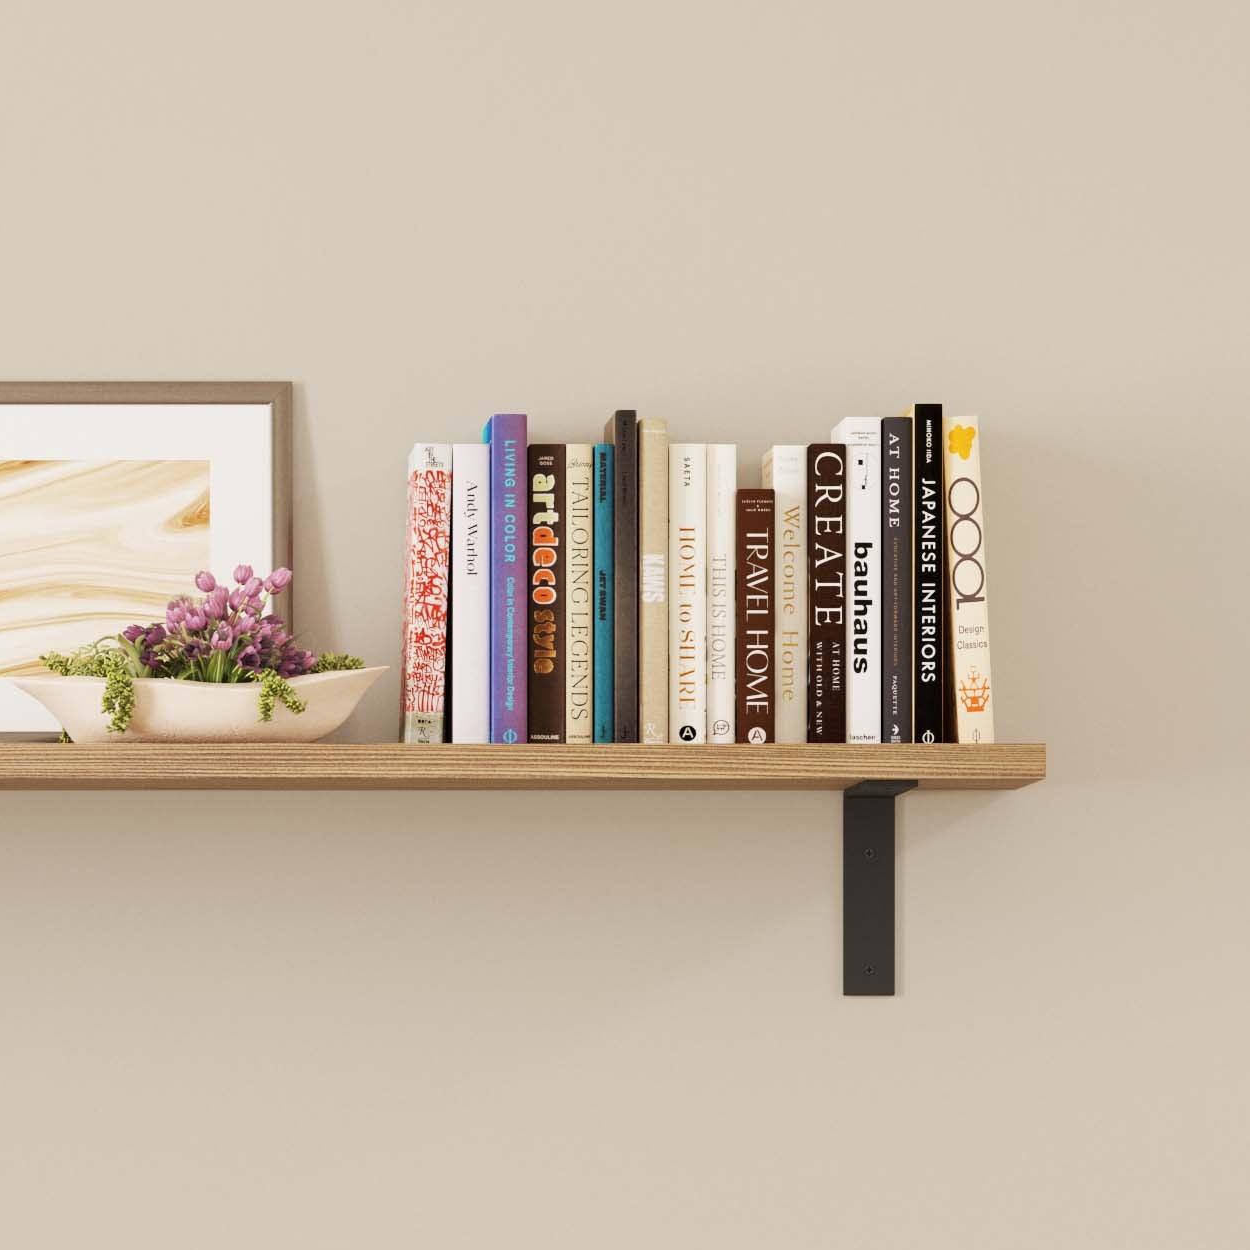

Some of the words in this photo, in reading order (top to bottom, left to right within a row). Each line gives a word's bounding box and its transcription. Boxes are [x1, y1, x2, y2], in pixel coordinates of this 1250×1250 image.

[504, 440, 516, 487] LIVING
[889, 433, 900, 458] AT
[464, 481, 478, 521] Andy
[504, 494, 515, 508] IN
[889, 467, 900, 528] HOME
[467, 524, 478, 576] Warhol
[504, 514, 516, 563] COLOR
[571, 478, 590, 603] TAILORING
[814, 451, 844, 626] CREATE
[921, 478, 936, 573] JAPANESE
[506, 576, 514, 595] Color
[642, 554, 664, 603] KAWS
[679, 526, 695, 595] HOME
[712, 554, 727, 599] THIS
[746, 528, 769, 621] TRAVEL
[783, 506, 800, 615] Welcome
[507, 598, 514, 606] in
[679, 603, 692, 622] to
[712, 603, 727, 620] IS
[853, 542, 872, 673] bauhaus
[505, 607, 515, 657] Contemporary
[533, 610, 557, 674] style
[712, 625, 727, 680] HOME
[833, 641, 840, 655] AT
[922, 583, 936, 683] INTERIORS
[957, 641, 988, 650] Classics
[958, 625, 985, 635] Design
[507, 659, 515, 684] Interior
[571, 612, 589, 720] LEGENDS
[679, 630, 695, 709] SHARE
[746, 630, 769, 715] HOME
[782, 631, 798, 702] Home
[505, 687, 515, 711] Design
